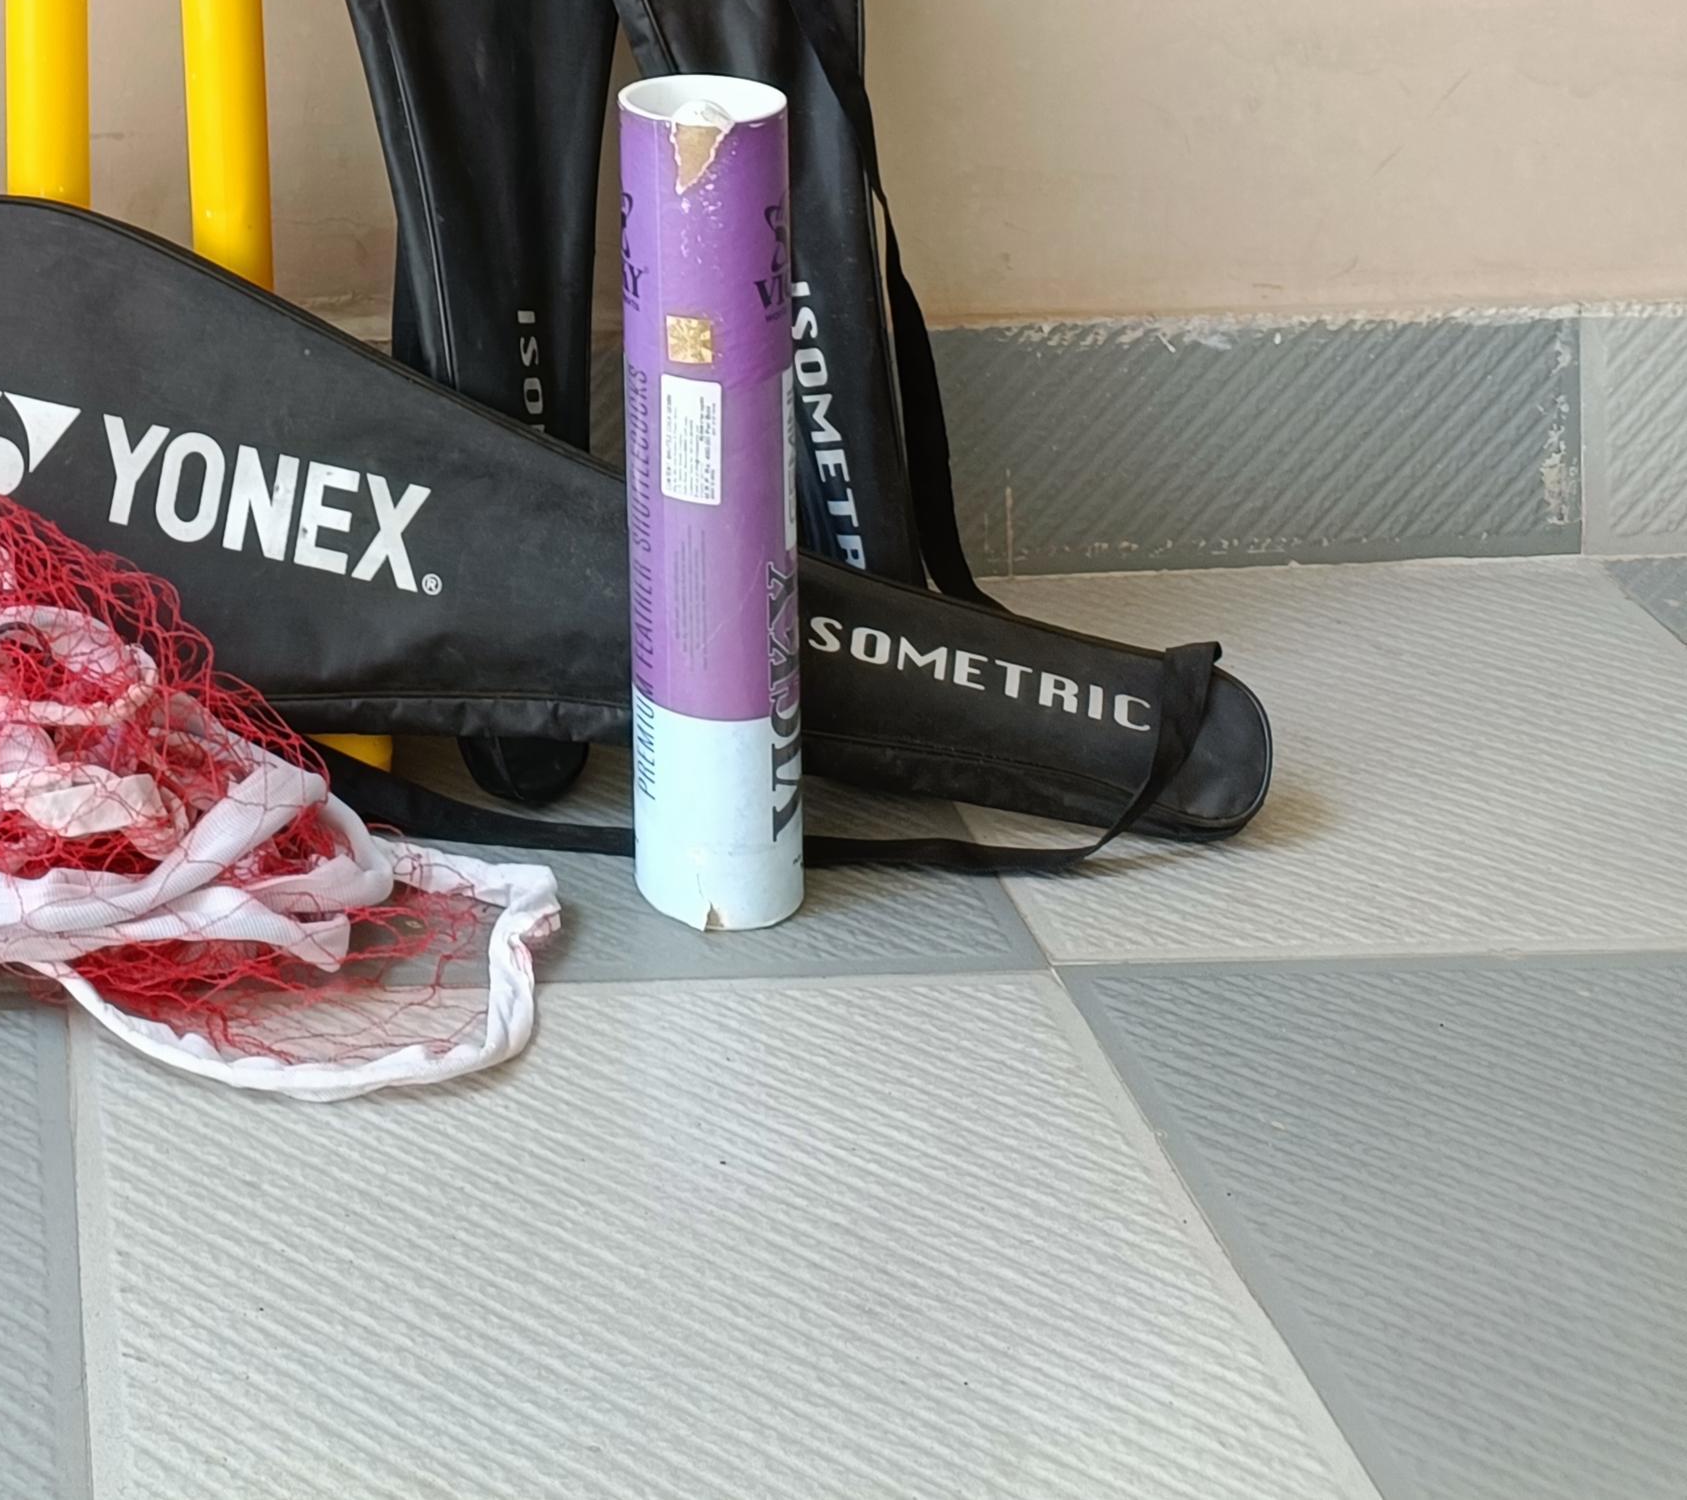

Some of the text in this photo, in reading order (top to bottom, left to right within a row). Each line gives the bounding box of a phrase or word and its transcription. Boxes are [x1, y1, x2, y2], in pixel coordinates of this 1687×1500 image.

[517, 310, 545, 433] ISO
[103, 413, 431, 593] YONEX
[628, 365, 655, 801] PREMIUM FEATHER SHUTTLECOCKS
